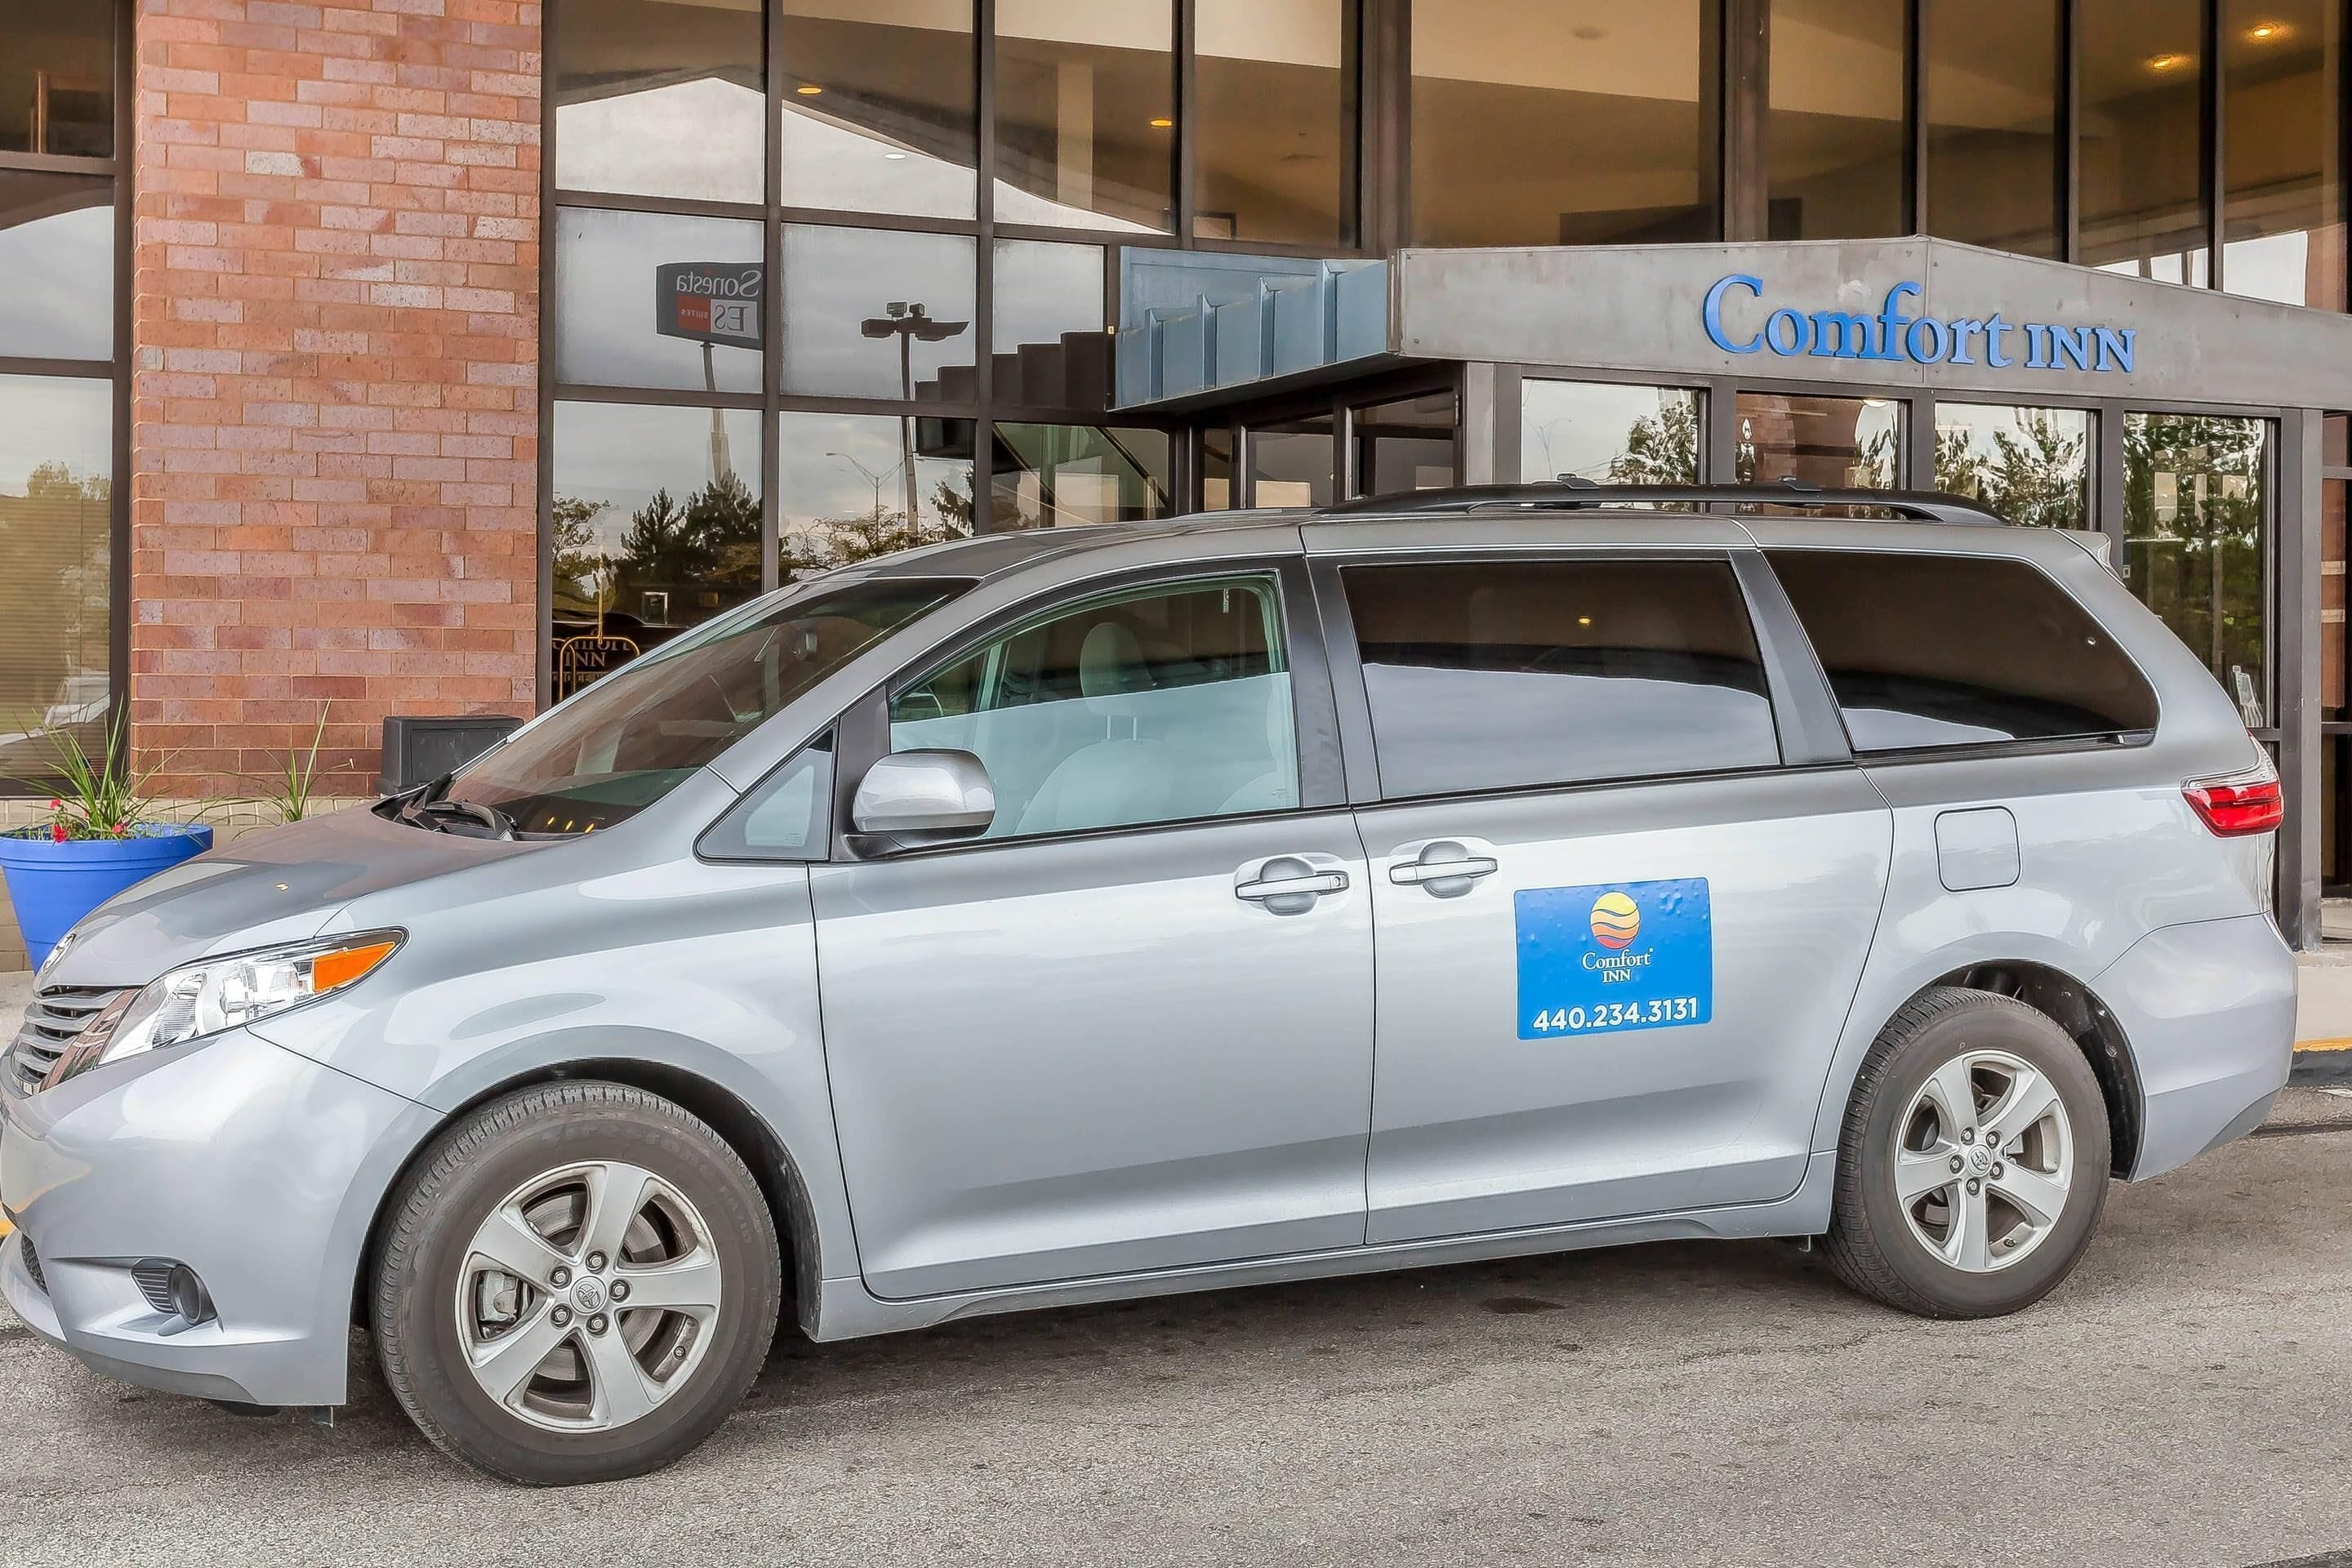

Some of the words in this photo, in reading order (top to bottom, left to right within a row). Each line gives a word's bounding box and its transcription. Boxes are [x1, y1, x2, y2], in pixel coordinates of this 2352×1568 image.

[1703, 274, 2014, 368] Comfort
[2025, 323, 2136, 372] INN
[564, 651, 607, 667] INN
[1582, 948, 1652, 970] Comfort
[1602, 969, 1632, 984] INN
[1532, 996, 1699, 1032] 440.234.3131
